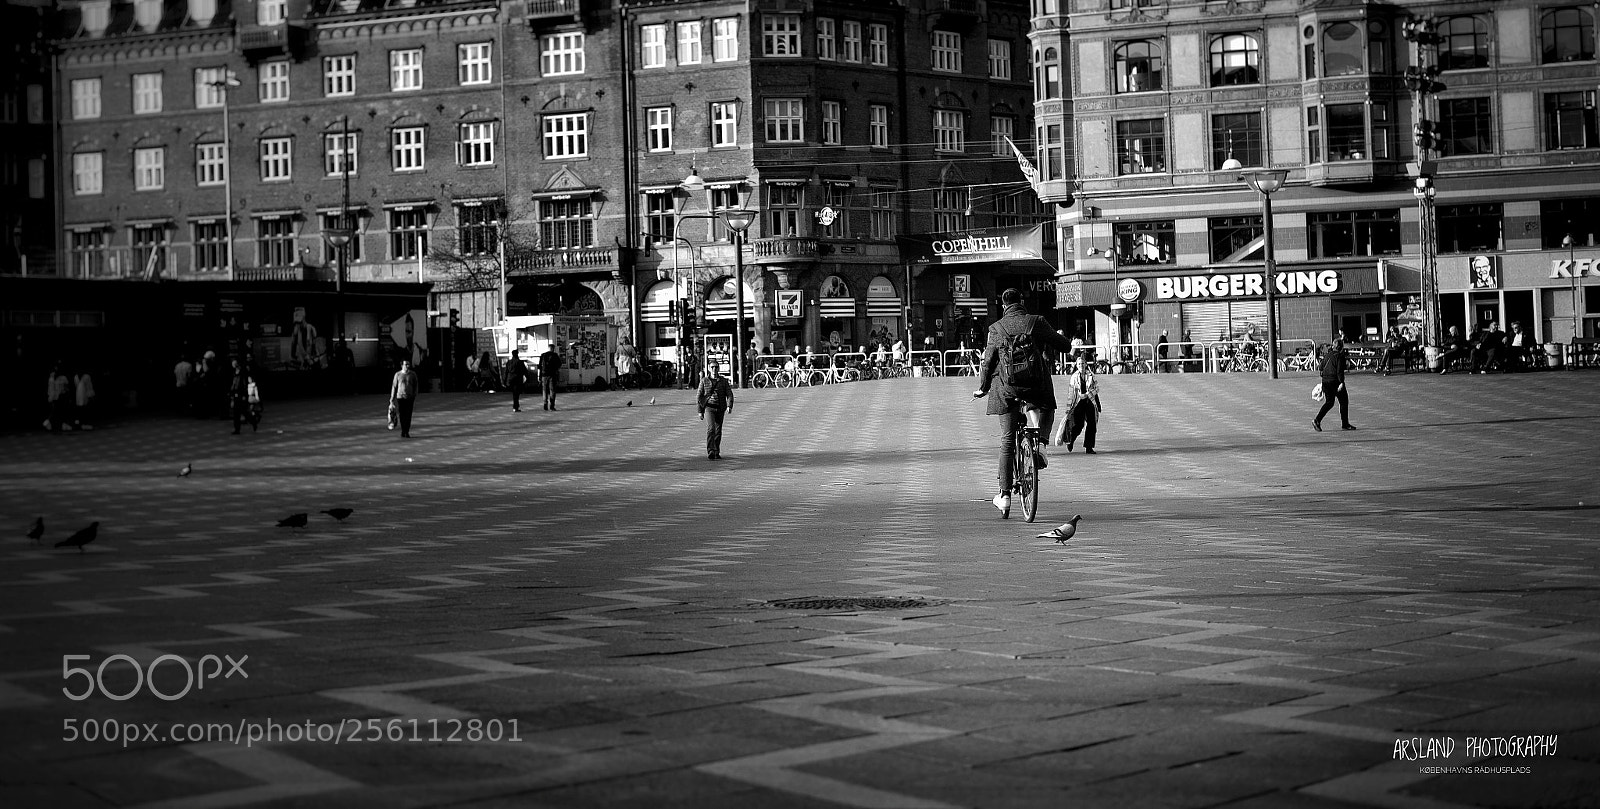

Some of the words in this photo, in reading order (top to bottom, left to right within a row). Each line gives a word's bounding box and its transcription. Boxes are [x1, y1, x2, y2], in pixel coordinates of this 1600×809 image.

[932, 236, 1011, 253] COPENHELL
[1157, 274, 1263, 299] BURGER
[1275, 270, 1338, 294] KING
[782, 294, 798, 316] 7
